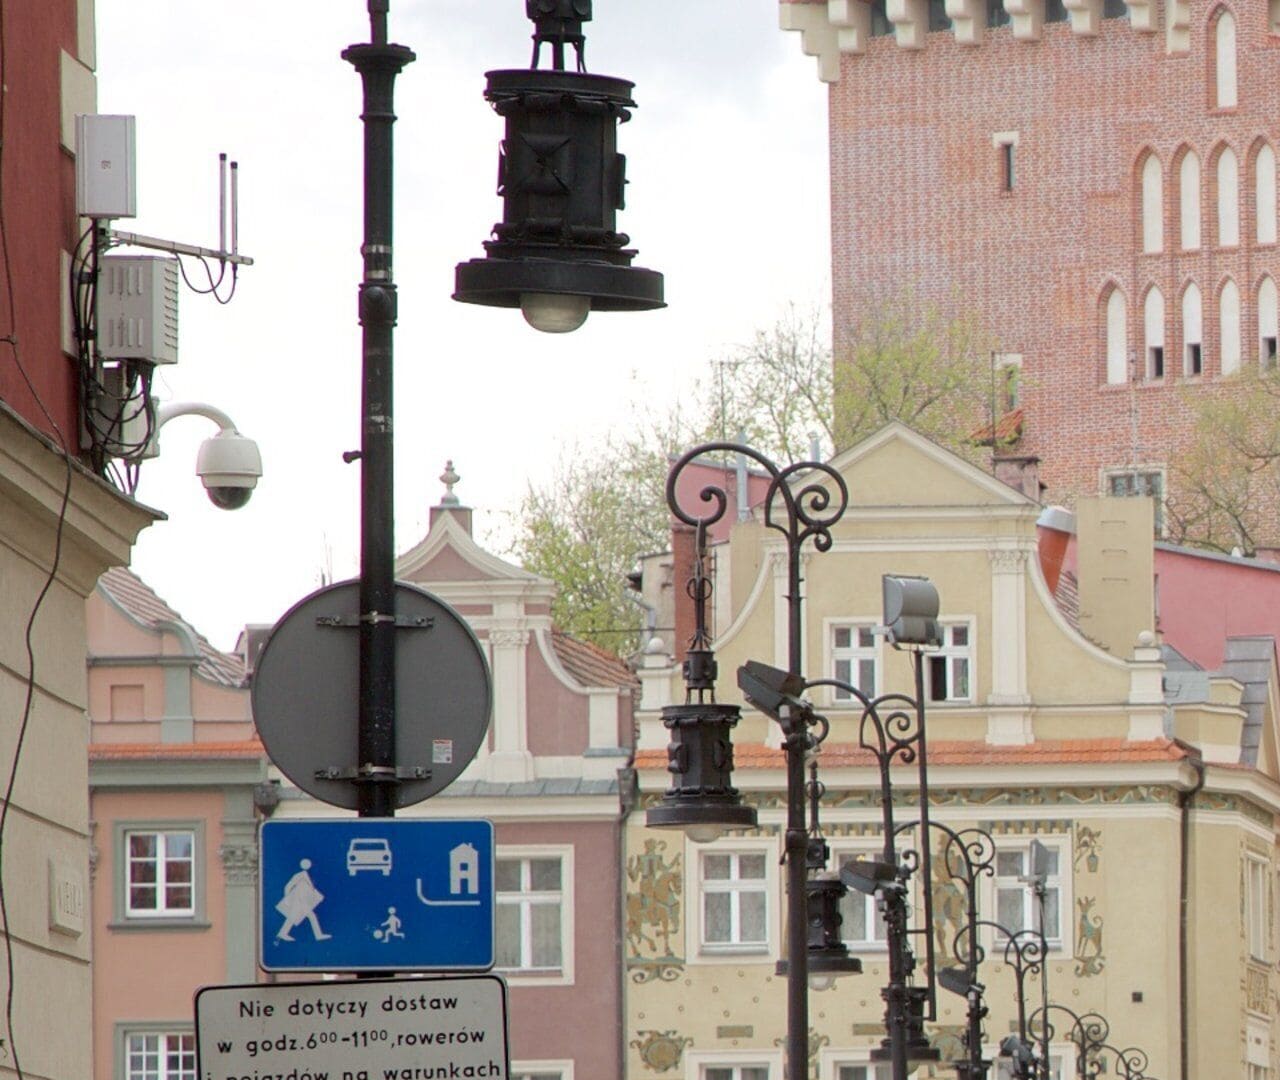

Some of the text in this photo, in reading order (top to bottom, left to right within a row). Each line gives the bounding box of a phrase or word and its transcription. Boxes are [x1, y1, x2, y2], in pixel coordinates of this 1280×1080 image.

[239, 994, 458, 1019] Nie dotyczy dostaw
[217, 1041, 232, 1053] w
[383, 1060, 500, 1080] warunkach
